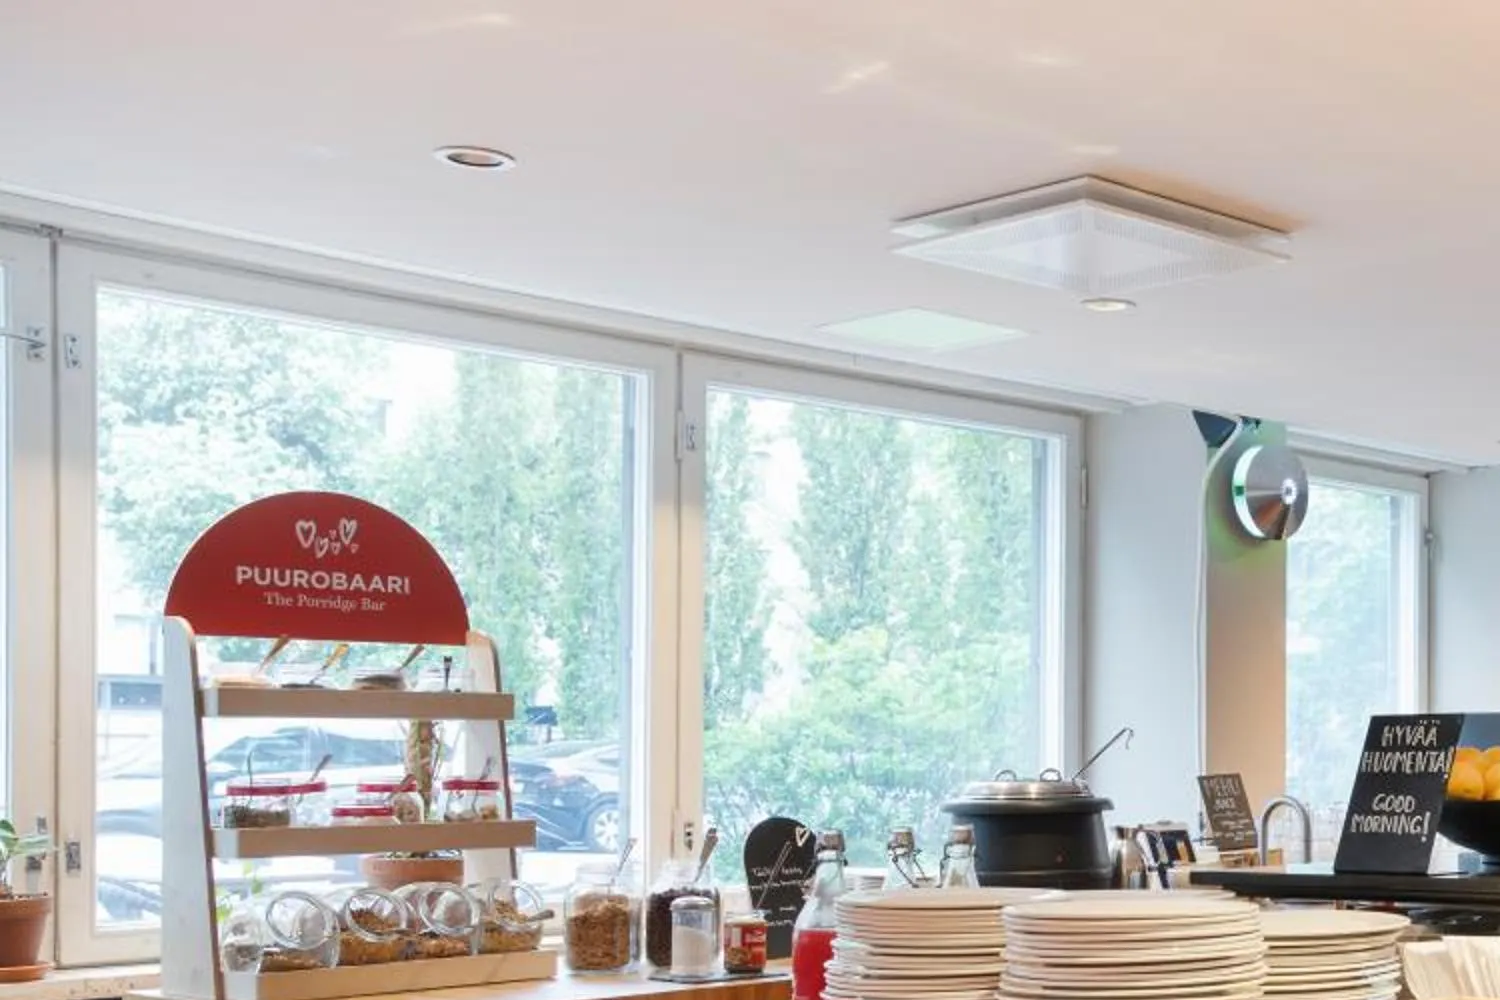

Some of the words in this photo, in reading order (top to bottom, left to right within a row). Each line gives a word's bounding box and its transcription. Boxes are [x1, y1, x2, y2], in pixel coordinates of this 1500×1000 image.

[236, 565, 410, 595] PUUROBAARI
[264, 591, 293, 607] The
[297, 594, 357, 613] Porridge
[361, 597, 387, 611] Bar
[1381, 719, 1442, 747] HYVÄÄ
[1361, 746, 1456, 779] HUOMENTA!
[1371, 793, 1416, 813] GOOD
[1351, 811, 1431, 843] MORNING!
